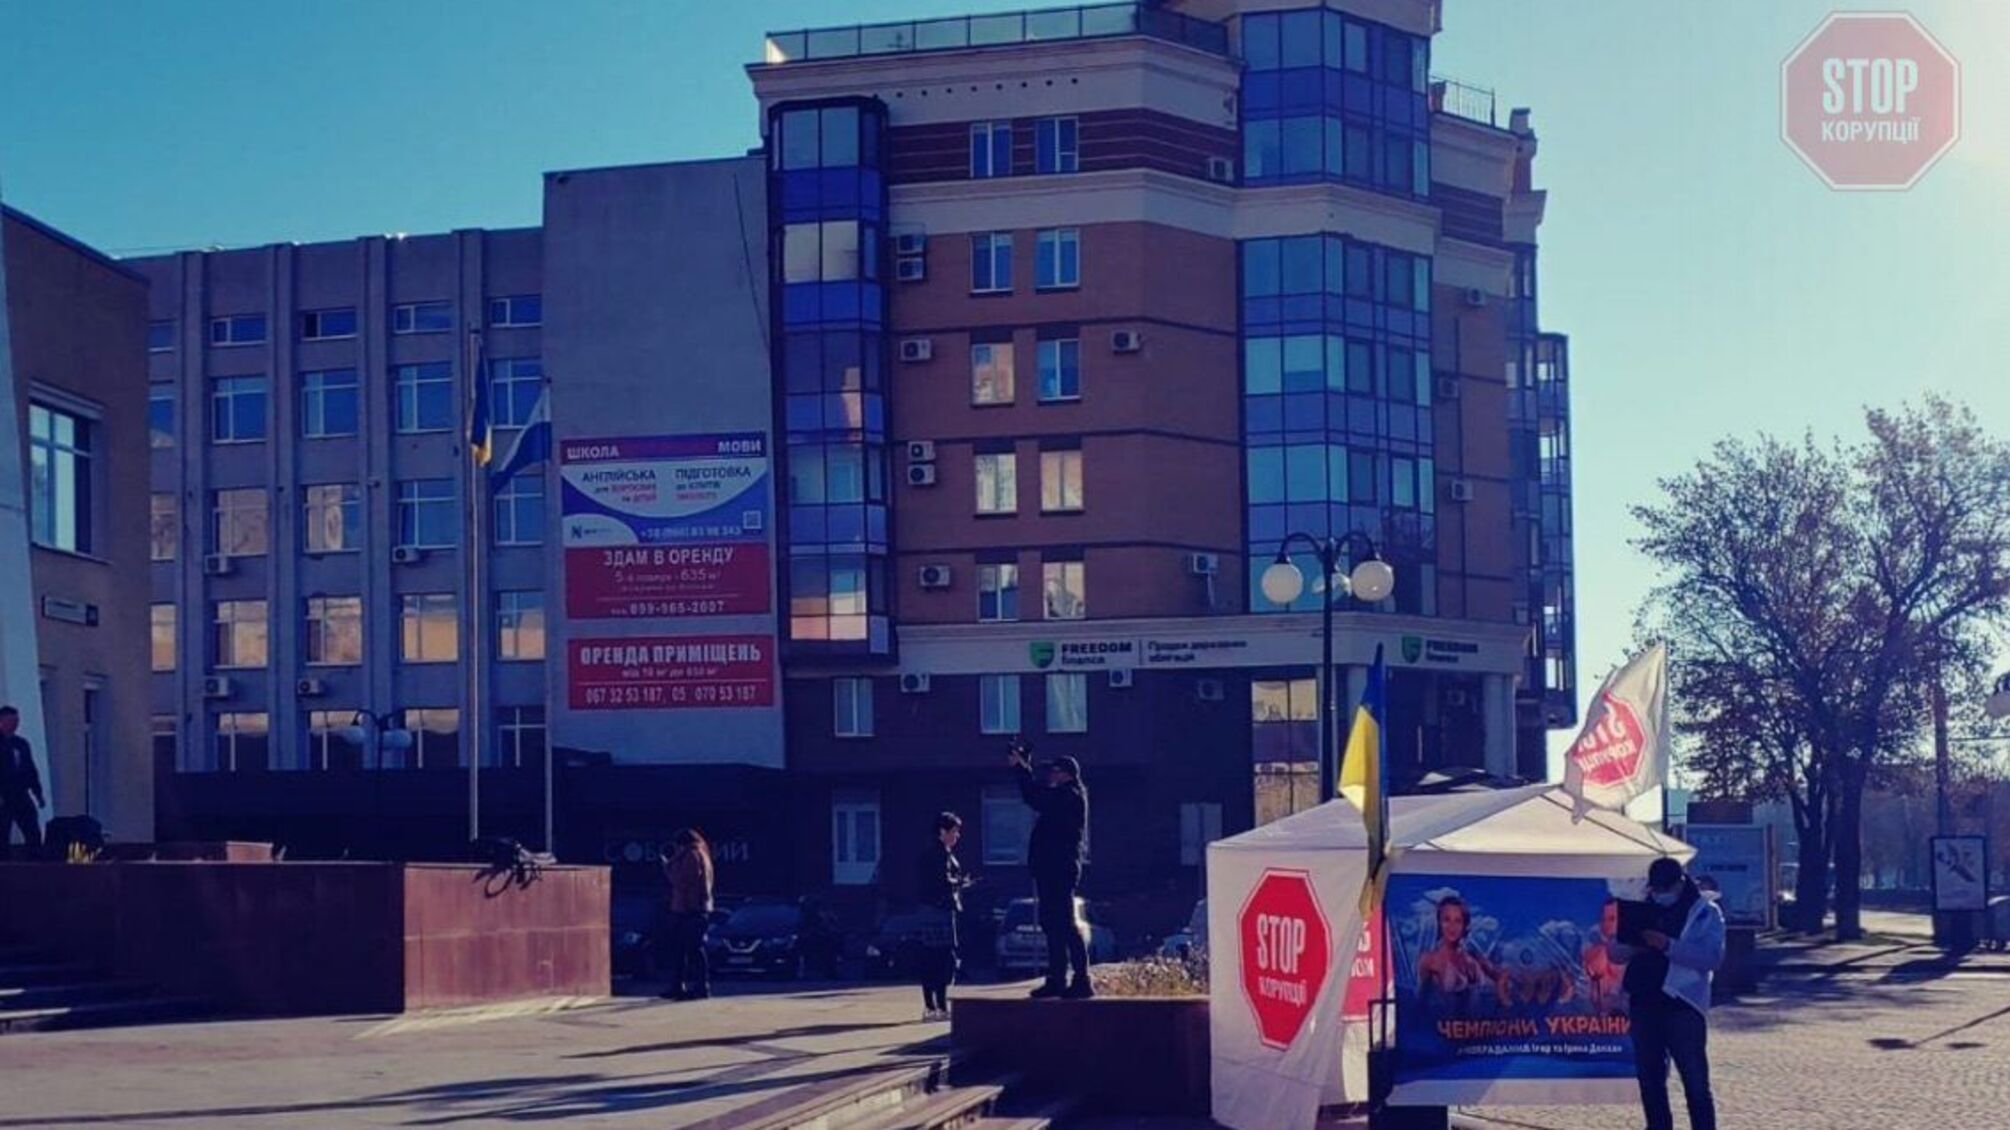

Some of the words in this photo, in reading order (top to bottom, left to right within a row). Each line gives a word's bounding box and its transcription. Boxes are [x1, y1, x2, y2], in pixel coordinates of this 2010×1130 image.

[567, 445, 620, 460] ШКОЛА
[718, 439, 762, 454] МОВИ
[604, 550, 648, 567] ЗДАМ
[654, 552, 665, 565] В
[668, 547, 735, 564] ОРЕНДУ
[580, 647, 649, 666] ОРЕНДА
[653, 644, 761, 665] ПРИМІЩЕНЬ
[1061, 642, 1132, 653] FREEDOM
[1257, 913, 1306, 974] STOP
[1259, 976, 1307, 1006] КОРУПЦІЇ
[1437, 1020, 1538, 1040] ЧЕМПІОНИ
